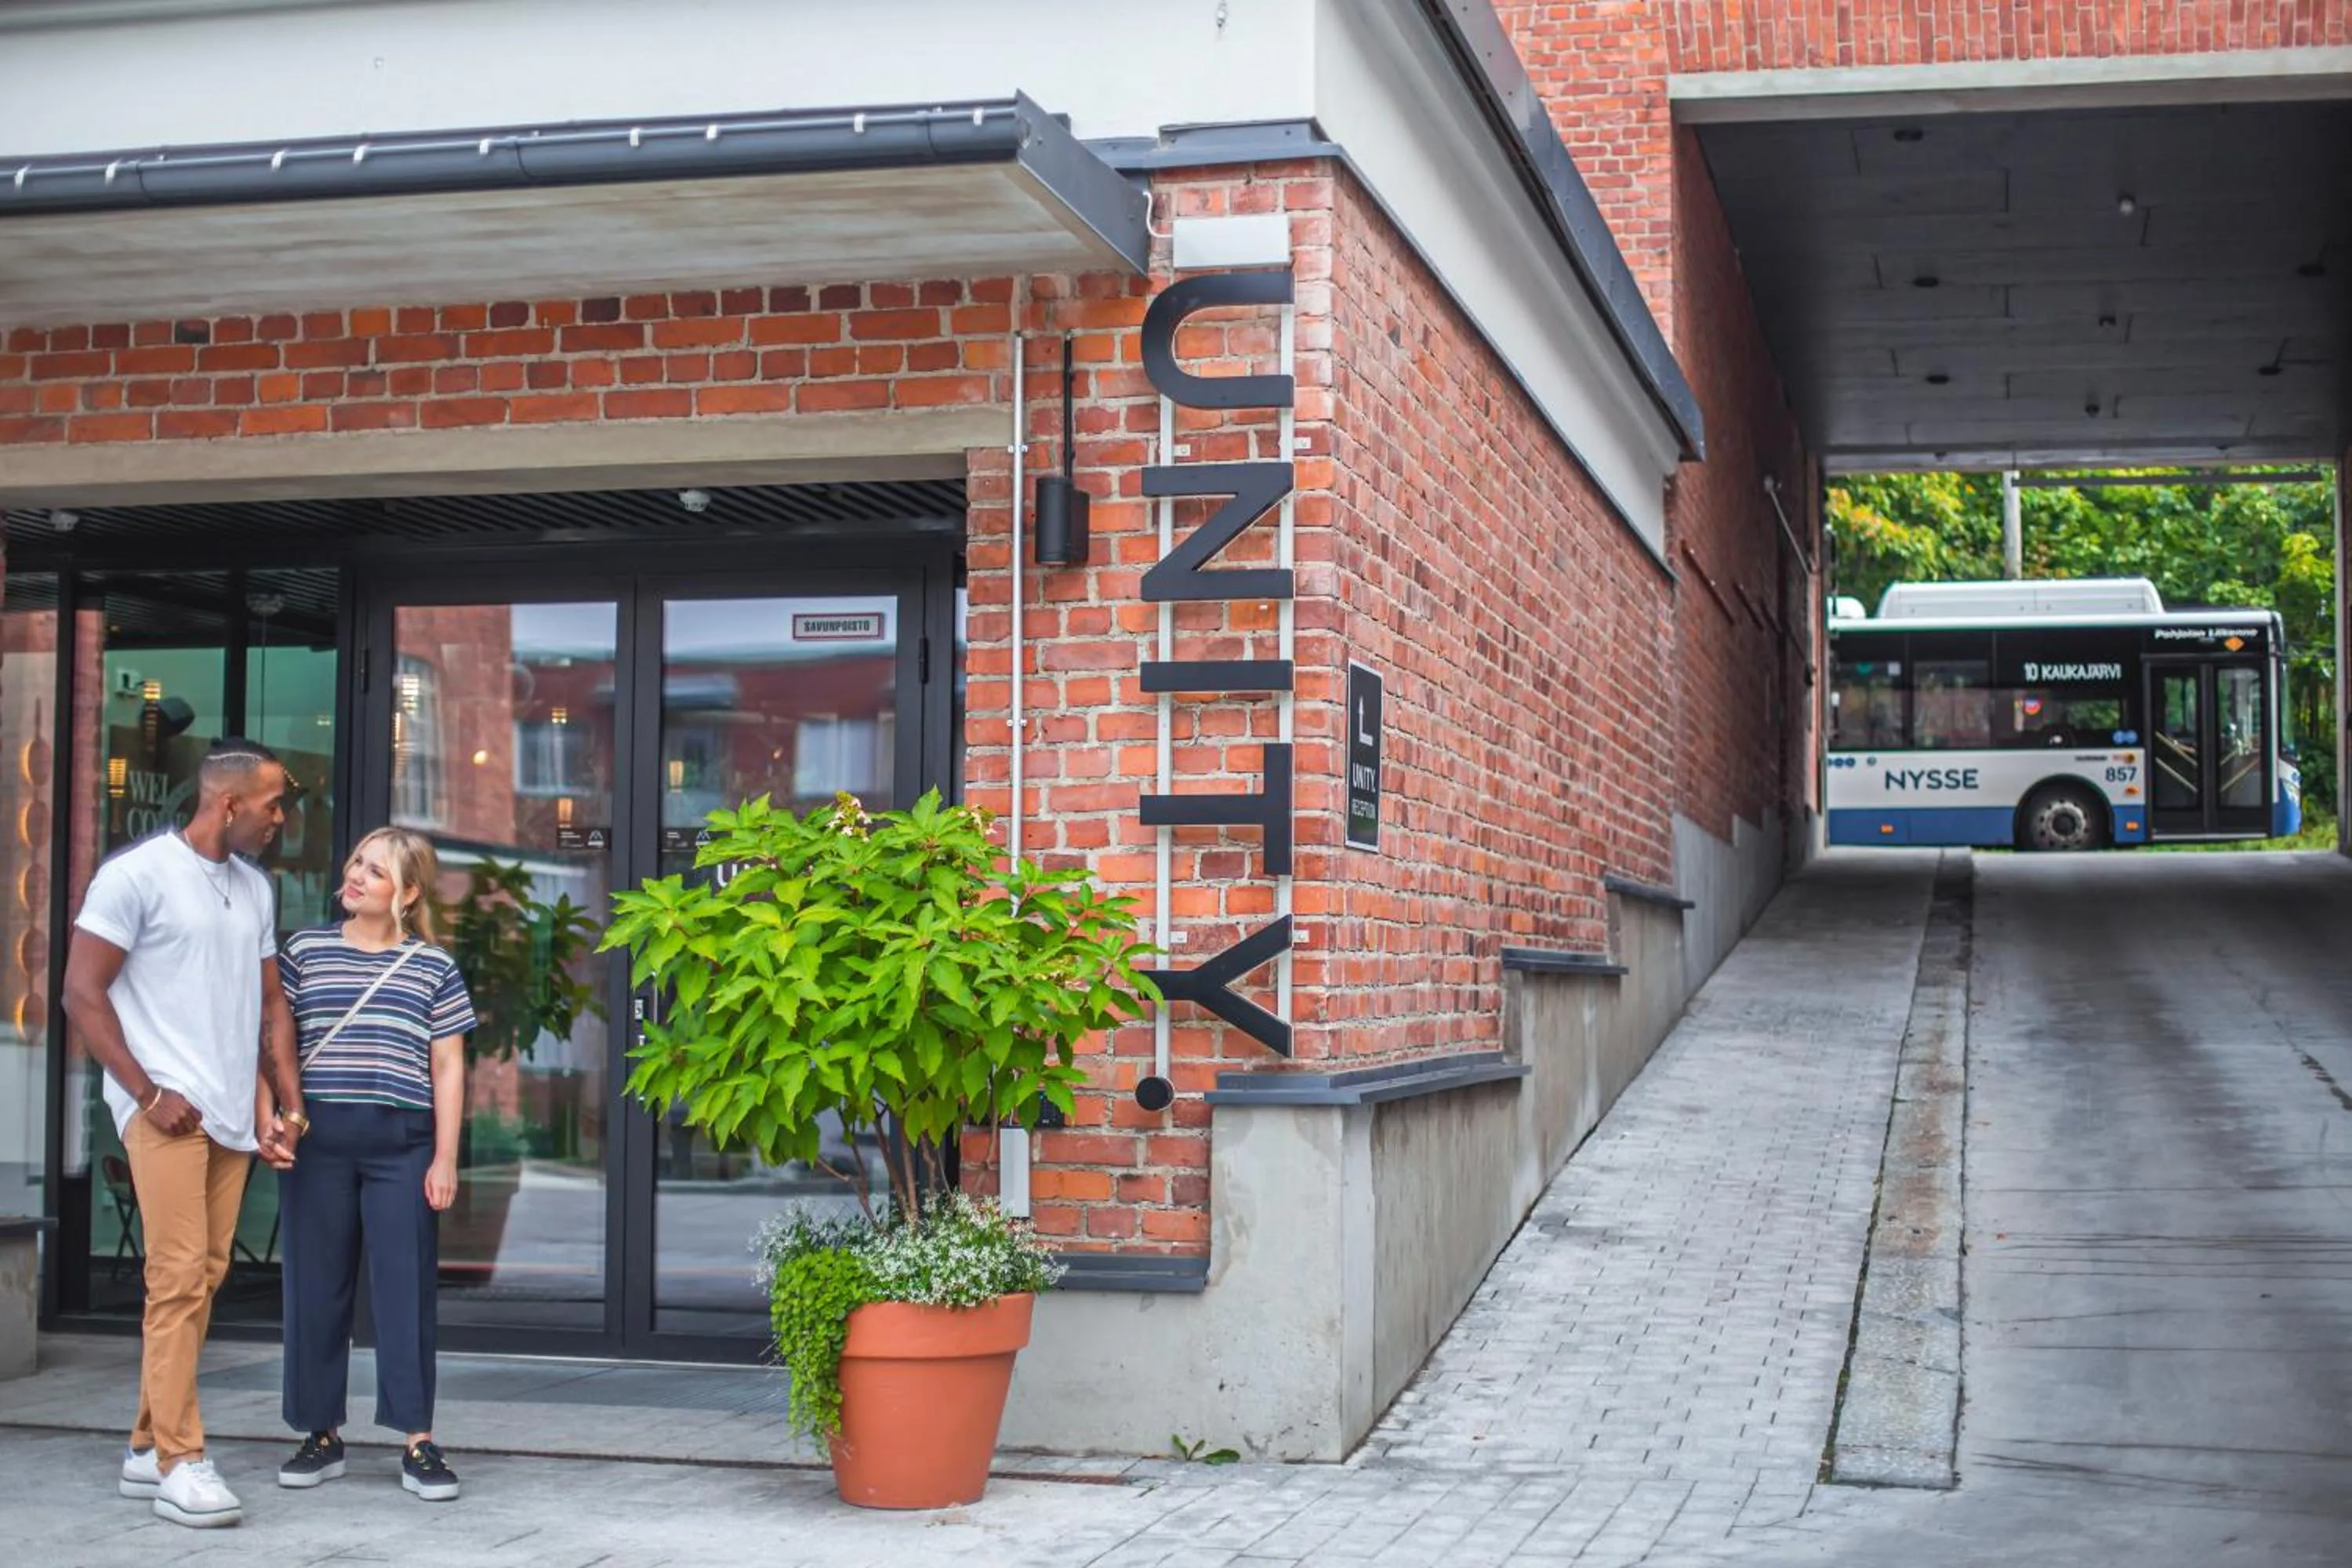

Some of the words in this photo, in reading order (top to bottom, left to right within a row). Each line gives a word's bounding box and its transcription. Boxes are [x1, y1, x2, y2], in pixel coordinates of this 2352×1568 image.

[804, 620, 870, 632] SAVUNPOISTO
[1885, 768, 1980, 790] NYSSE
[2106, 766, 2138, 782] 857
